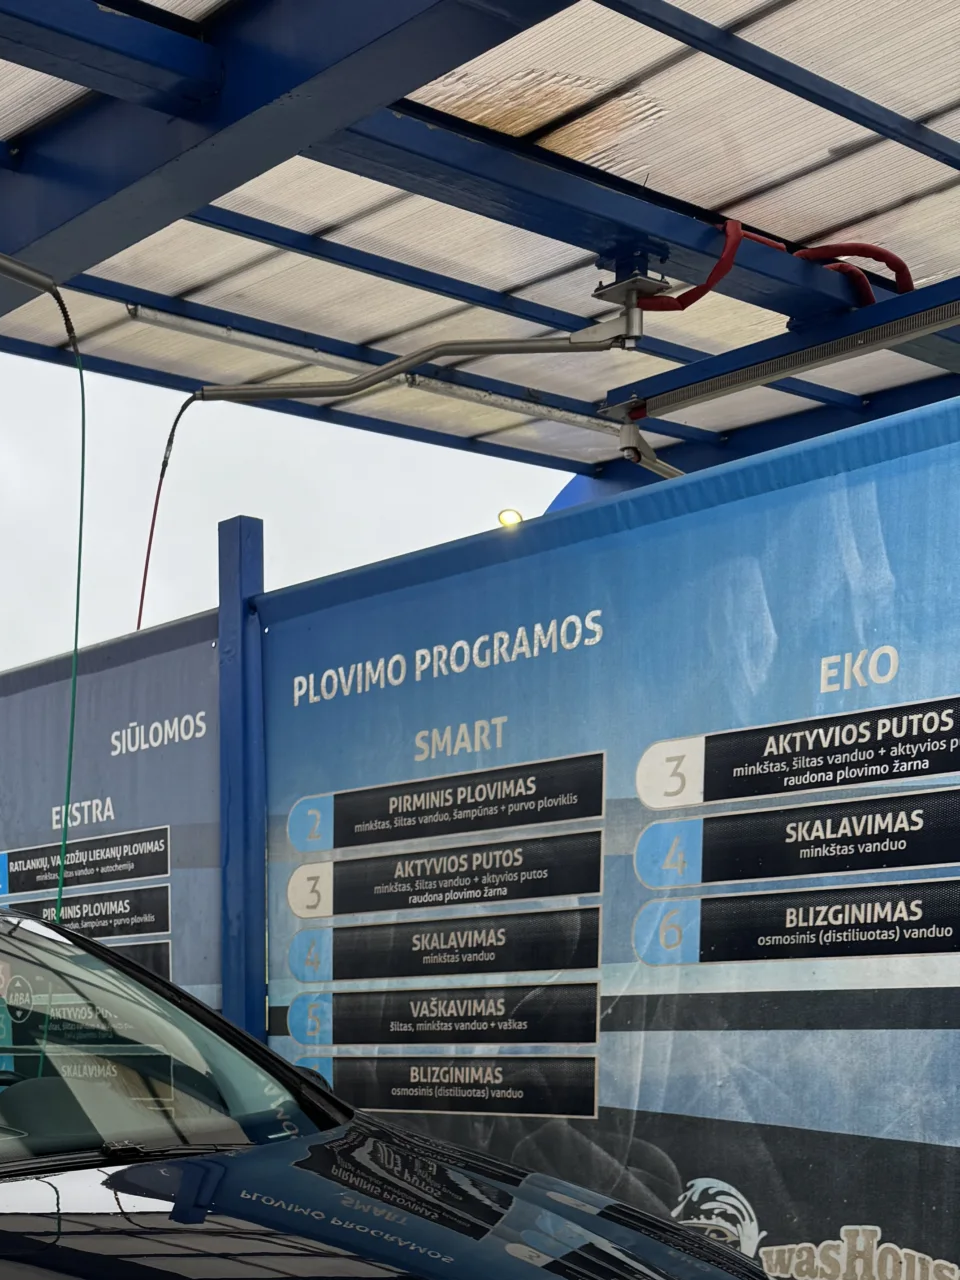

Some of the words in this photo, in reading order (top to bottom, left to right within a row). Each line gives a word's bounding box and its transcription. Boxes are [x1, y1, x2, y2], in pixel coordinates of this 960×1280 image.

[292, 653, 407, 707] PLOVIMO
[414, 609, 603, 681] PROGRAMOS
[819, 645, 899, 694] EKO
[110, 710, 207, 756] SIŪLOMOS
[413, 715, 508, 762] SMART
[763, 721, 871, 758] AKTYVIOS
[876, 708, 954, 741] PUTOS
[733, 760, 789, 778] minkštas,
[792, 754, 824, 772] šiltas
[827, 748, 874, 766] vanduo
[889, 738, 947, 760] aktyvios
[783, 769, 834, 787] raudona
[836, 763, 889, 784] plovimo
[892, 757, 930, 774] žarna
[663, 754, 687, 797] 3
[388, 789, 454, 815] PIRMINIS
[456, 776, 537, 805] PLOVIMAS
[51, 796, 115, 830] EKSTRA
[306, 809, 321, 840] 2
[354, 818, 392, 833] minkštas,
[393, 815, 417, 828] šiltas
[418, 811, 451, 826] vanduo,
[452, 804, 498, 824] šampūnas
[507, 800, 536, 816] purvo
[537, 793, 578, 811] ploviklis
[784, 809, 924, 844] SKALAVIMAS
[123, 839, 166, 857] PLOVIMAS
[394, 853, 469, 879] AKTYVIOS
[472, 847, 523, 870] PUTOS
[661, 835, 687, 877] 4
[799, 842, 855, 859] minkštas
[857, 838, 907, 854] vanduo
[305, 876, 321, 909] 3
[373, 880, 413, 895] minkštas,
[414, 877, 438, 891] šiltas
[438, 875, 471, 888] vanduo
[481, 870, 519, 886] aktyvios
[520, 868, 548, 883] putos
[408, 891, 443, 904] raudona
[444, 887, 482, 903] plovimo
[483, 885, 508, 897] žarna
[83, 899, 130, 917] PLOVIMAS
[785, 899, 923, 928] BLIZGINIMAS
[411, 928, 506, 952] SKALAVIMAS
[658, 908, 684, 951] 6
[757, 932, 816, 947] osmosinis
[818, 928, 901, 947] (distiliuotas)
[903, 925, 953, 940] vanduo
[304, 940, 321, 973] 4
[422, 952, 460, 965] minkštas
[461, 951, 496, 963] vanduo
[305, 1003, 321, 1037] 5
[410, 998, 506, 1018] VAŠKAVIMAS
[416, 1019, 453, 1031] minkštas
[454, 1019, 488, 1031] vanduo
[497, 1018, 528, 1031] vaškas
[409, 1065, 504, 1085] BLIZGINIMAS
[391, 1086, 434, 1097] osmosinis
[434, 1086, 489, 1100] (distiliuotas)
[490, 1087, 524, 1099] vanduo
